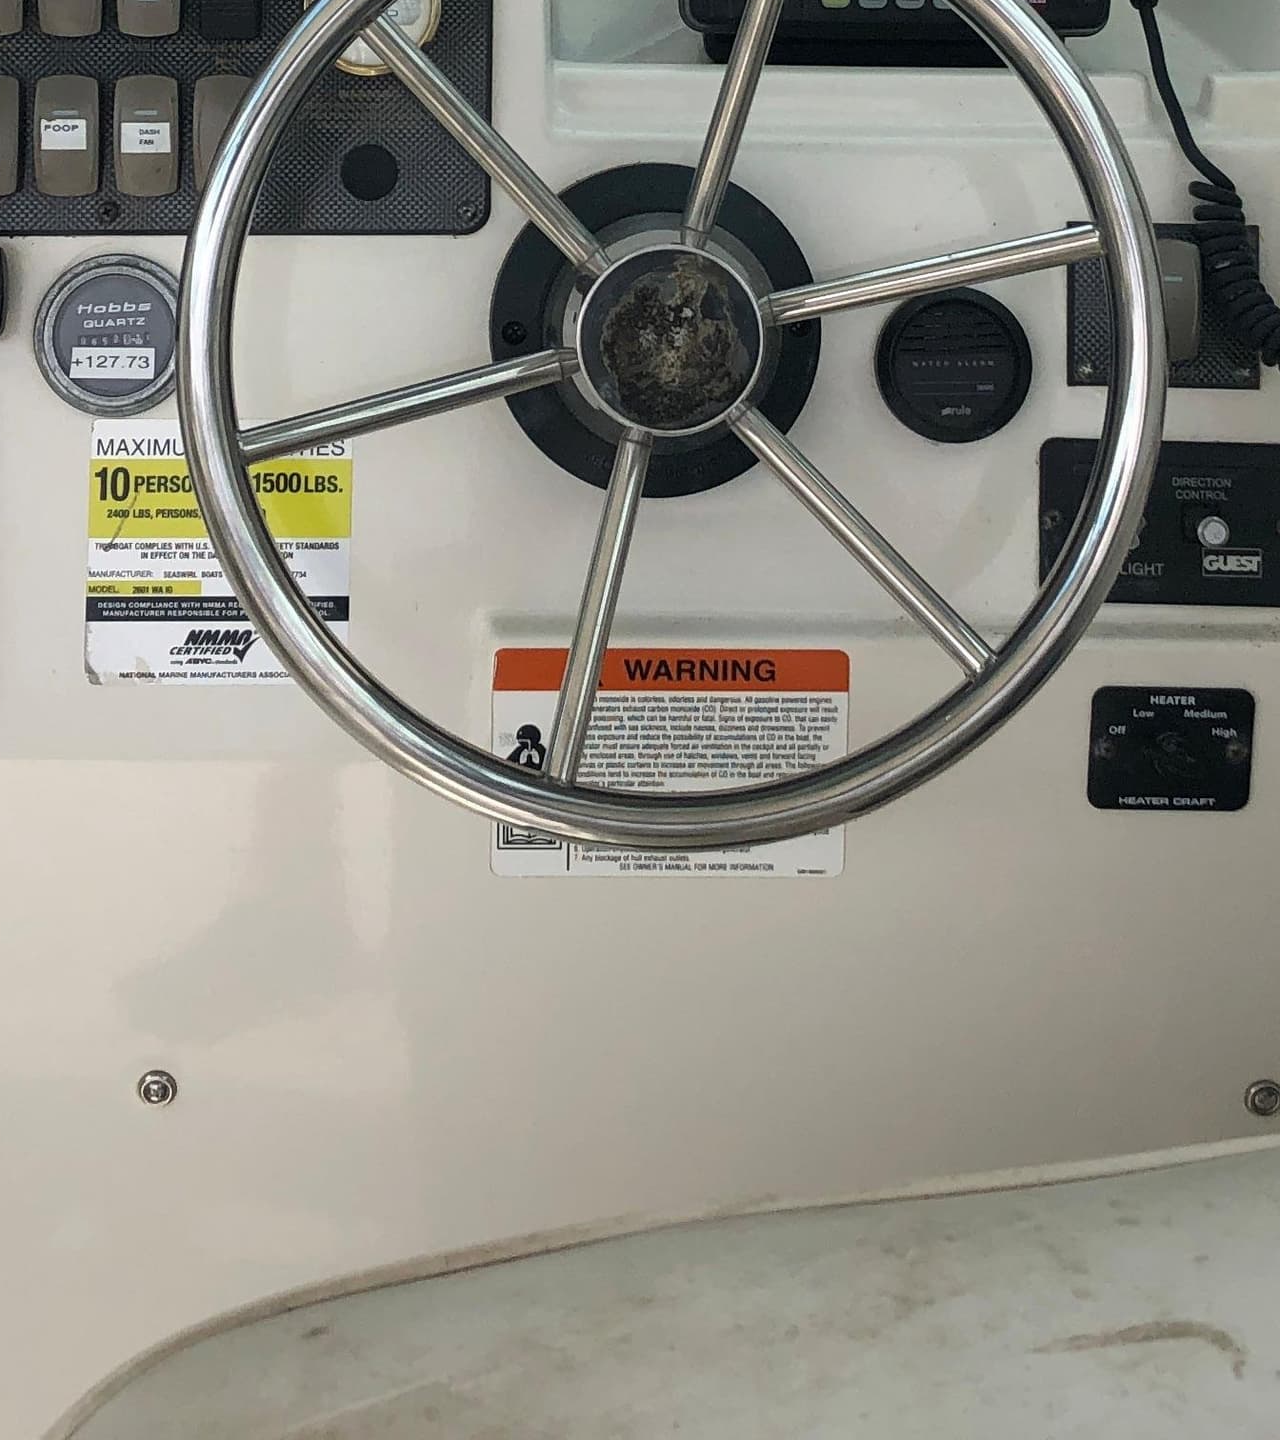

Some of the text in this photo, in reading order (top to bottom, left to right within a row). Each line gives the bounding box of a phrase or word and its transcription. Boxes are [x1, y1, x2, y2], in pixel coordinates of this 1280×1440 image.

[77, 302, 152, 314] Hobbs
[83, 317, 145, 328] QUARTZ
[72, 356, 150, 369] +127.73
[97, 439, 185, 456] MAXIMU
[95, 467, 130, 501] 10
[252, 472, 301, 493] 1500
[304, 475, 343, 493] LBS.
[1172, 477, 1232, 488] DIRECTION
[1175, 489, 1229, 501] CONTROL
[1203, 555, 1262, 572] GUEST
[170, 646, 232, 655] CERTIFIED
[624, 659, 776, 682] WARNING
[1150, 695, 1196, 706] HEATER
[1132, 709, 1155, 718] Low
[1184, 709, 1228, 719] Medium
[1108, 725, 1127, 735] Off
[1212, 727, 1238, 739] High
[1118, 797, 1216, 806] HEATER CRAFT
